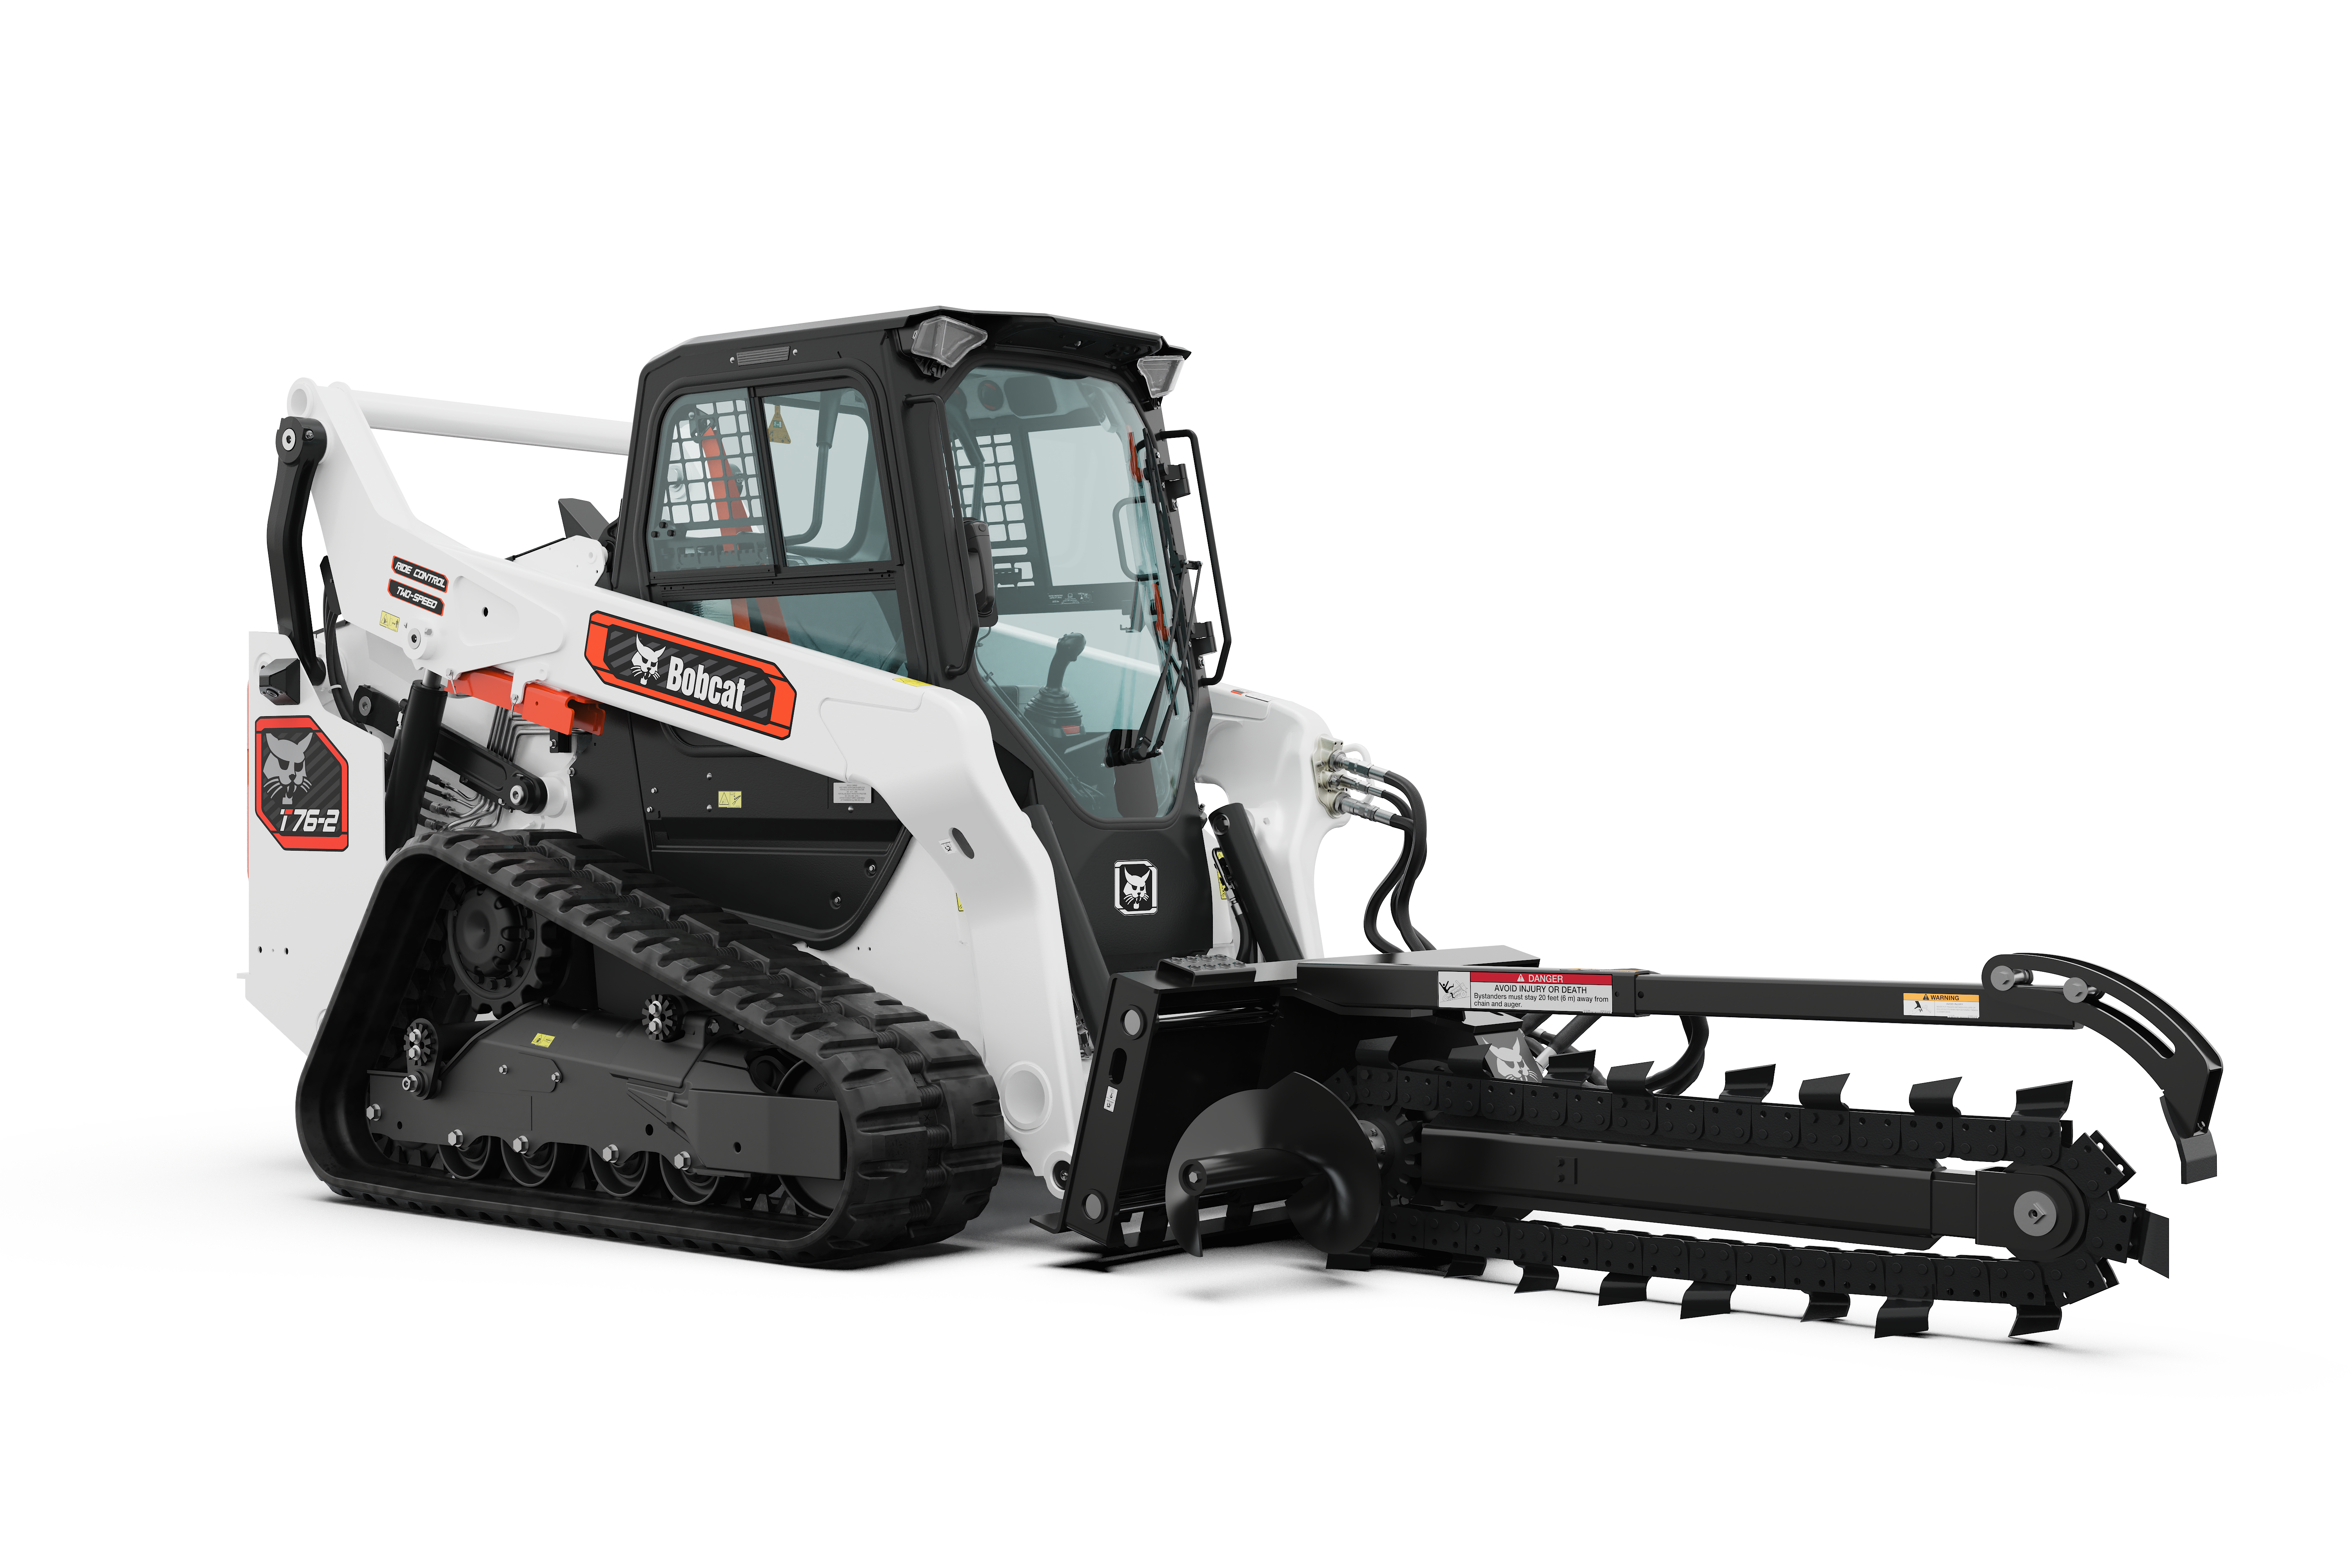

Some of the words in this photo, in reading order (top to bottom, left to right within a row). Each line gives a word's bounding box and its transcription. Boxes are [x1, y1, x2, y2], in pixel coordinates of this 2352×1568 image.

[394, 561, 413, 574] RIDE
[413, 569, 445, 588] CONTROL
[397, 586, 438, 609] TWO-SPEED
[666, 655, 746, 712] Bobcat
[280, 809, 340, 832] T76-2
[1528, 974, 1563, 983] DANGER
[814, 1081, 828, 1093] BERC
